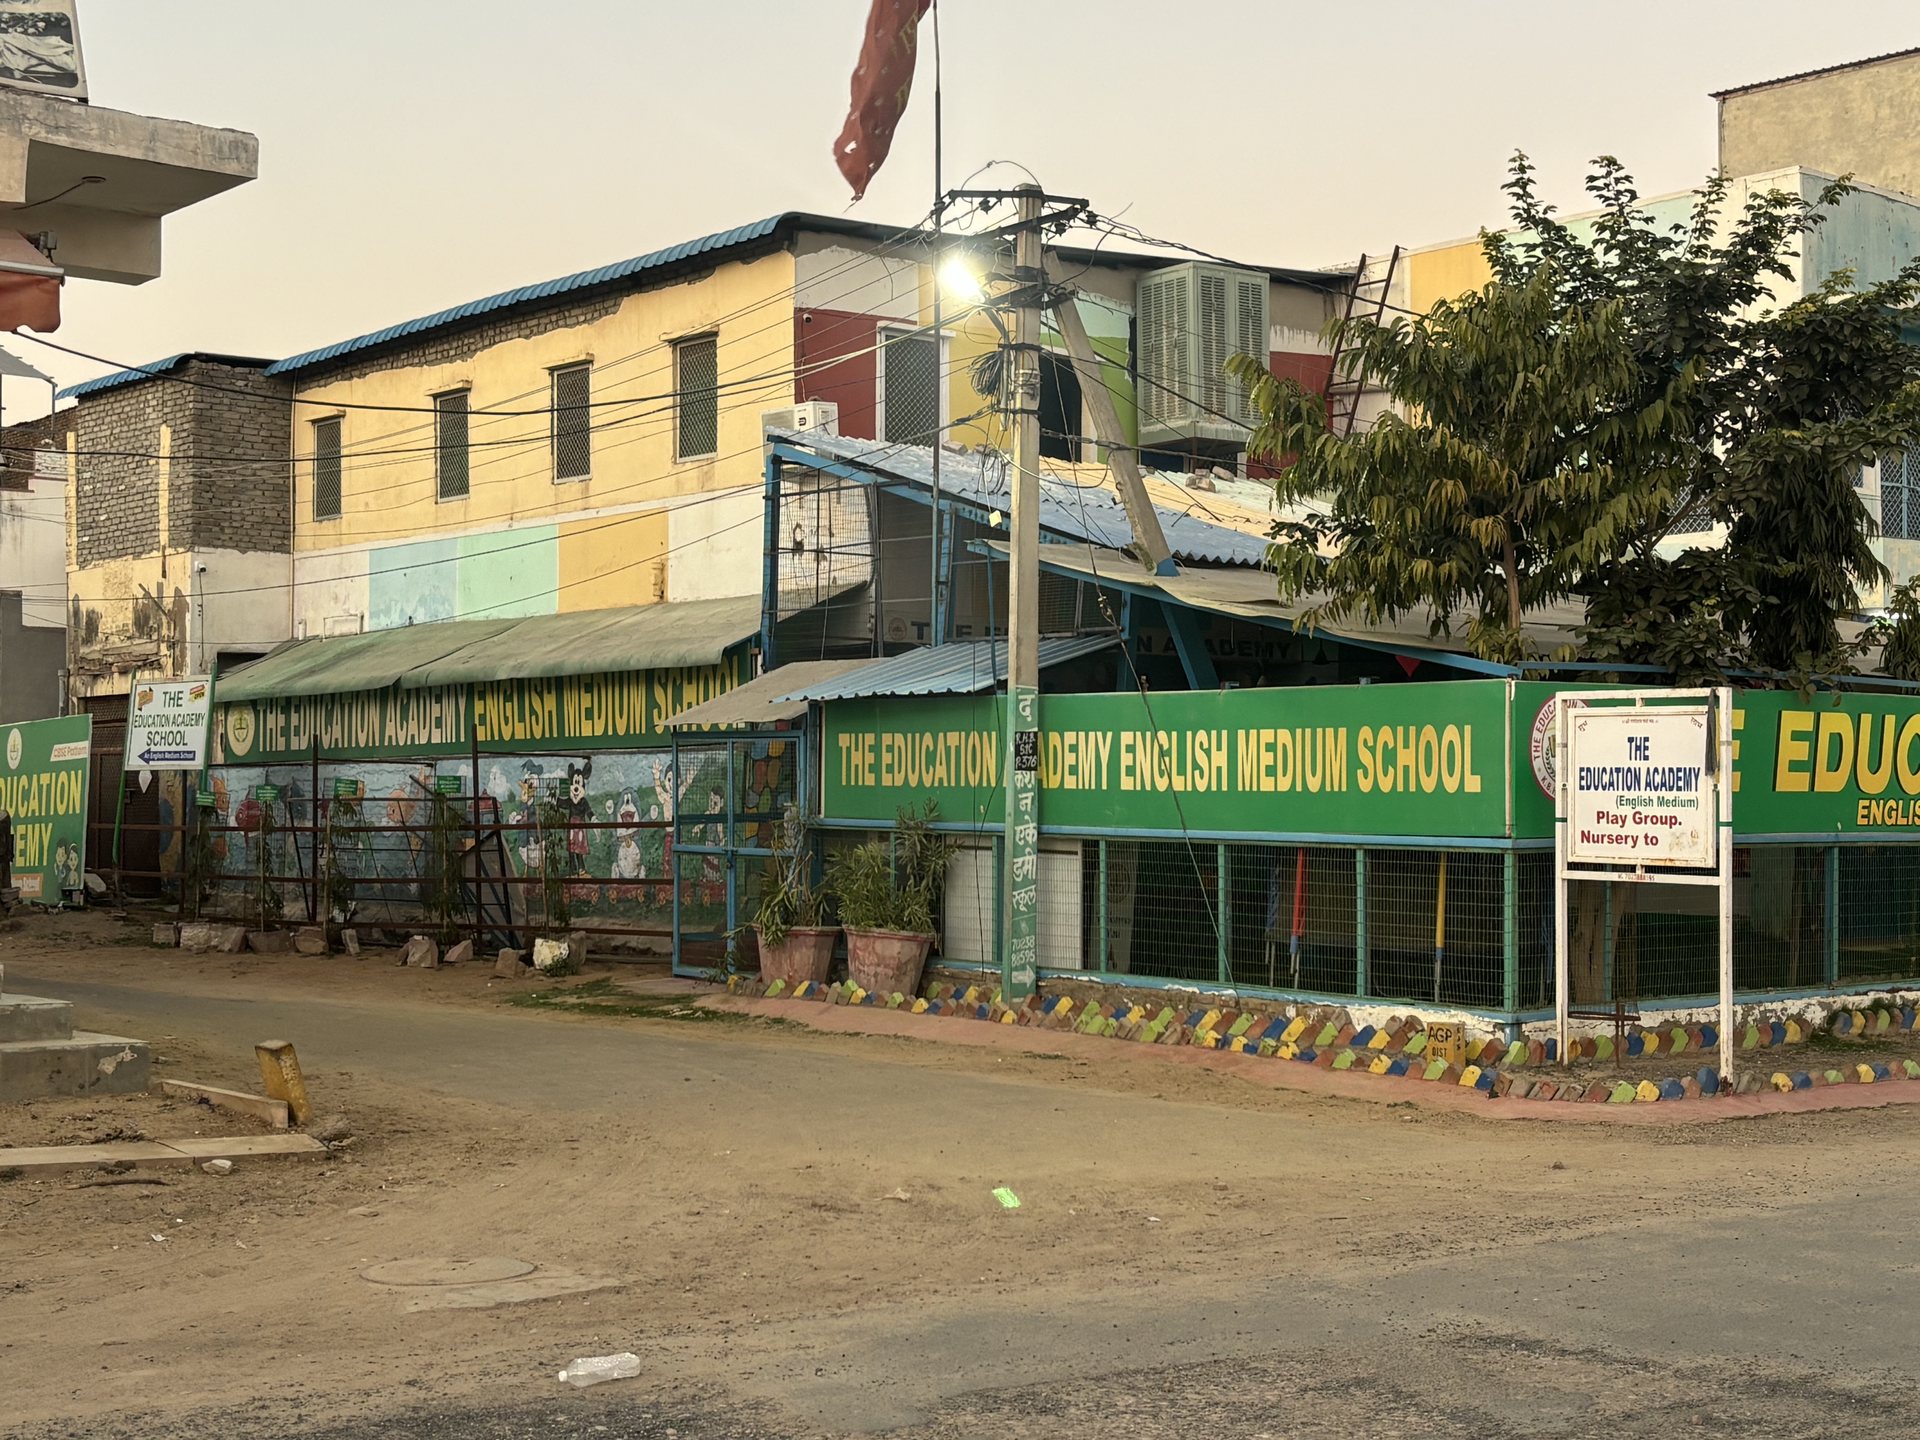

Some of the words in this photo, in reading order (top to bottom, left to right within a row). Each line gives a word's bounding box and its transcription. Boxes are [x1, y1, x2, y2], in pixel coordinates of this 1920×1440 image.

[163, 691, 184, 708] THE
[257, 697, 286, 752] THE
[290, 688, 380, 751] EDUCATION
[384, 683, 467, 746] ACADEMY
[474, 677, 558, 742] ENGLISH
[563, 669, 647, 738] MEDIUM
[134, 713, 170, 728] EDUCATION
[171, 712, 206, 727] ACADEMY
[146, 730, 188, 746] SCHOOL
[1627, 736, 1650, 761] THE
[838, 732, 876, 786] THE
[881, 731, 997, 787] EDUCATION
[1002, 731, 1112, 790] ADEMY
[1120, 730, 1228, 792] ENGLISH
[1237, 728, 1347, 792] MEDIUM
[1357, 724, 1481, 793] SCHOOL
[1579, 767, 1641, 791] EDUCATION
[1644, 767, 1700, 792] ACADEMY
[1615, 795, 1654, 810] (English
[1657, 796, 1699, 811] Medium)
[1596, 810, 1628, 828] Play
[1632, 811, 1682, 829] Group.
[1580, 830, 1639, 848] Nursery
[1644, 833, 1659, 846] to
[1428, 1026, 1452, 1043] AGP
